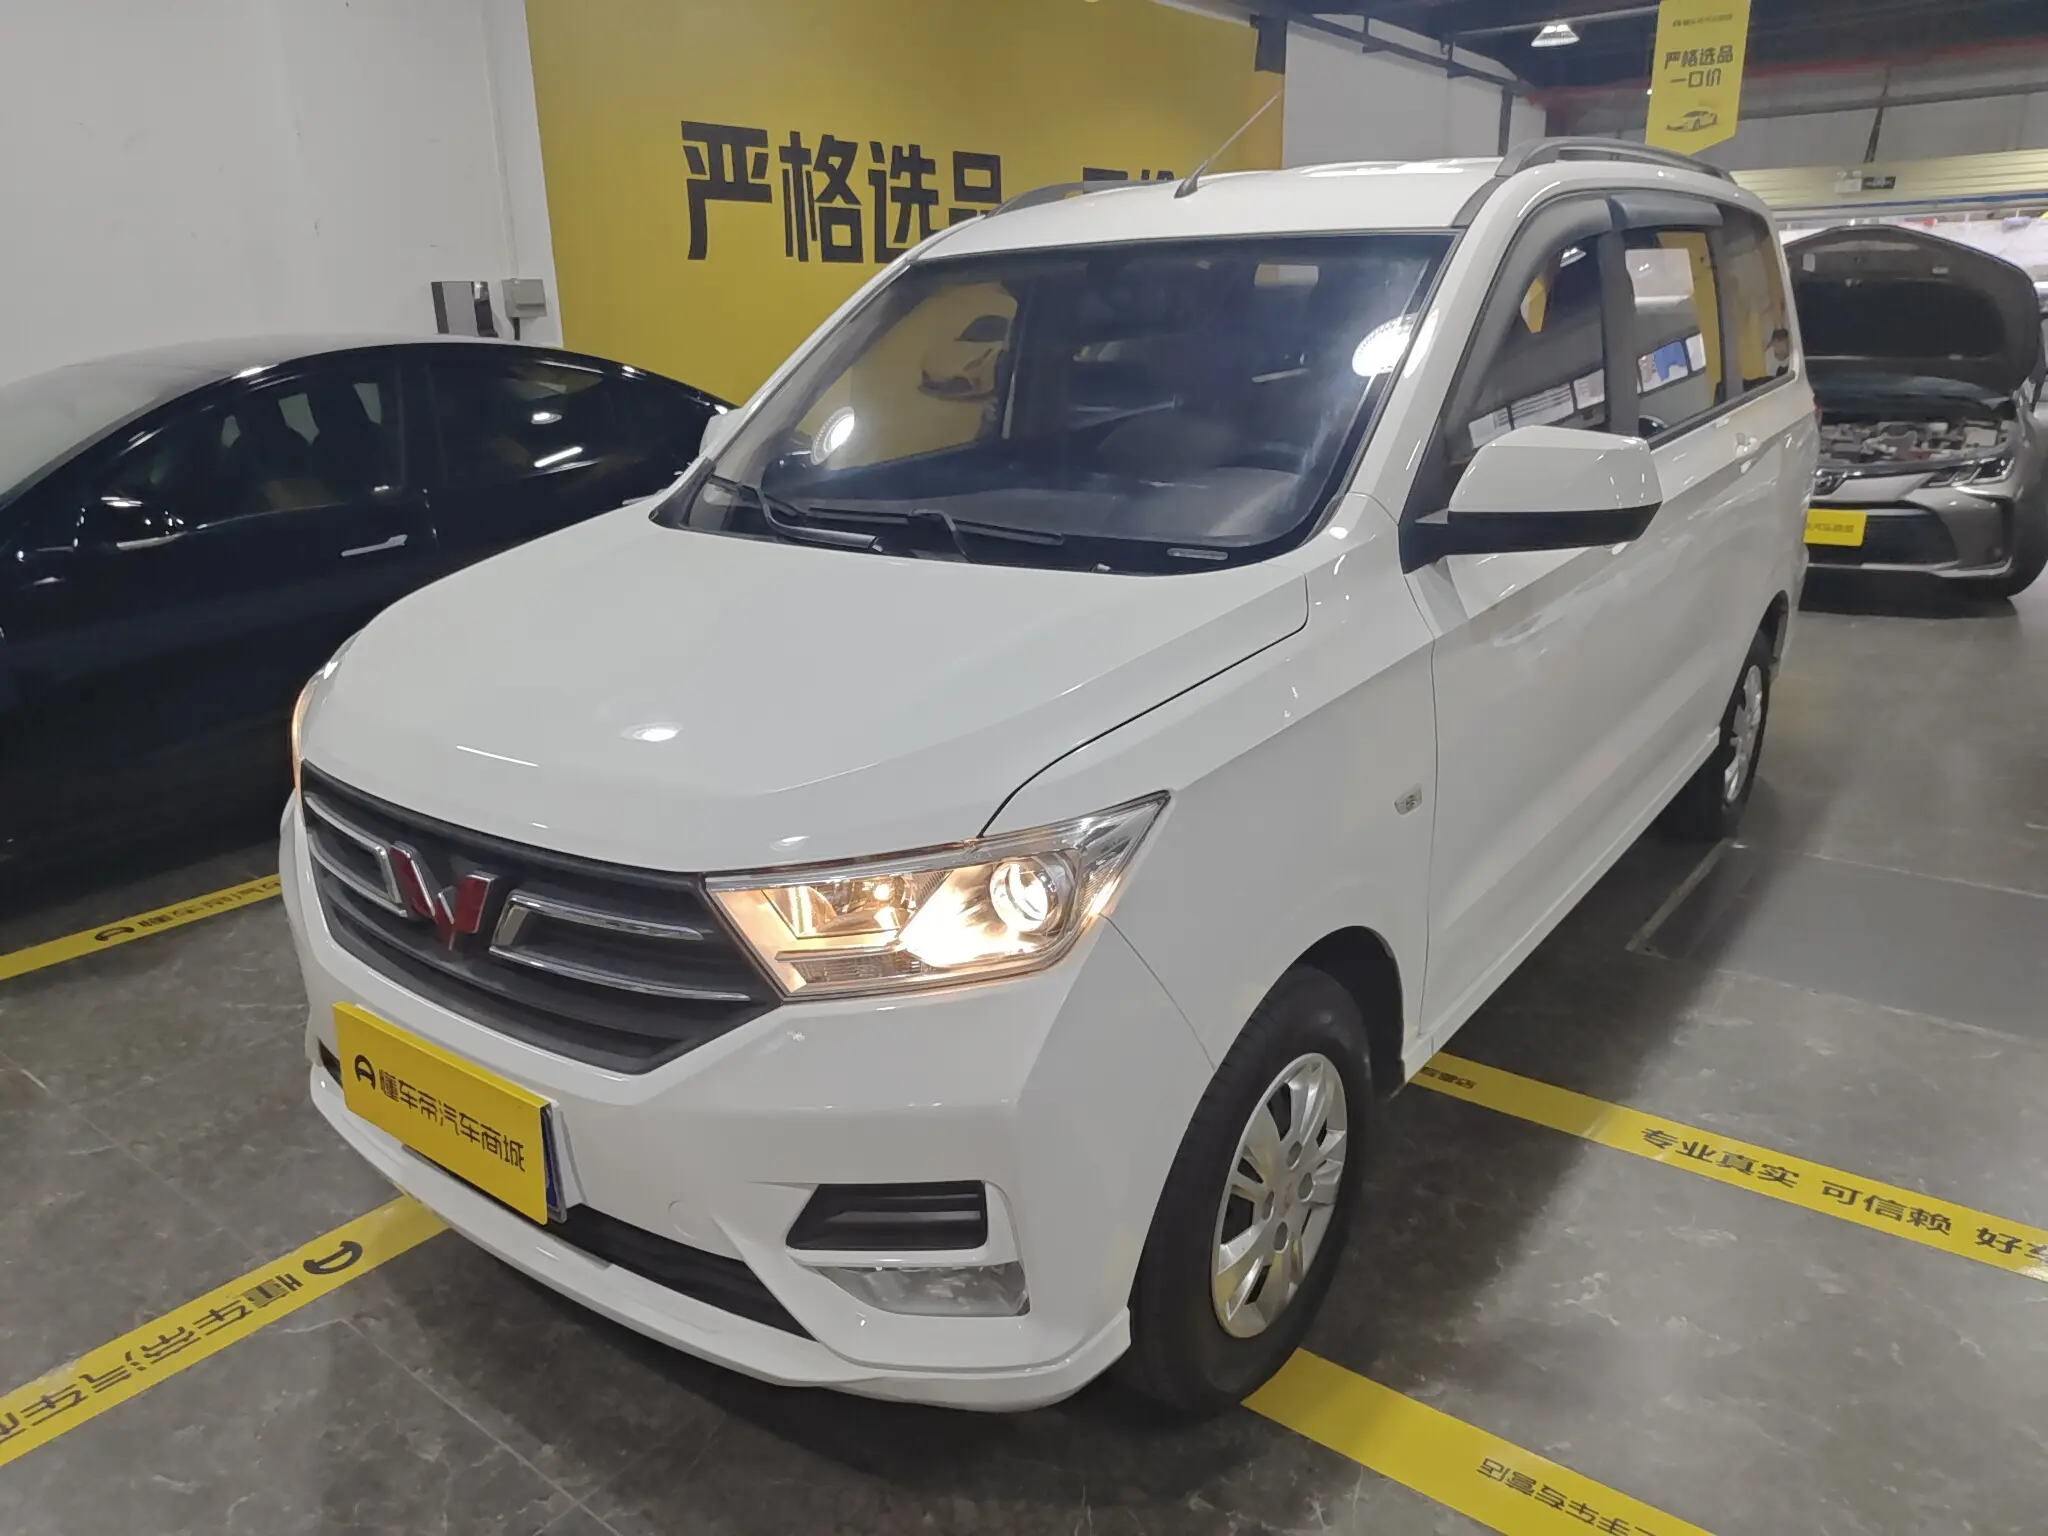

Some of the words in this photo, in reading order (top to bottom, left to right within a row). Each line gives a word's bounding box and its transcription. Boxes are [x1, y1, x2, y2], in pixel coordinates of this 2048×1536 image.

[1664, 45, 1733, 70] 严格选品
[1670, 68, 1721, 88] 一口价
[681, 120, 1002, 264] 严格选品
[379, 1067, 526, 1173] 懂车帝汽车商城
[1640, 1127, 1800, 1189] 专业真实
[1820, 1180, 1952, 1236] 可信赖
